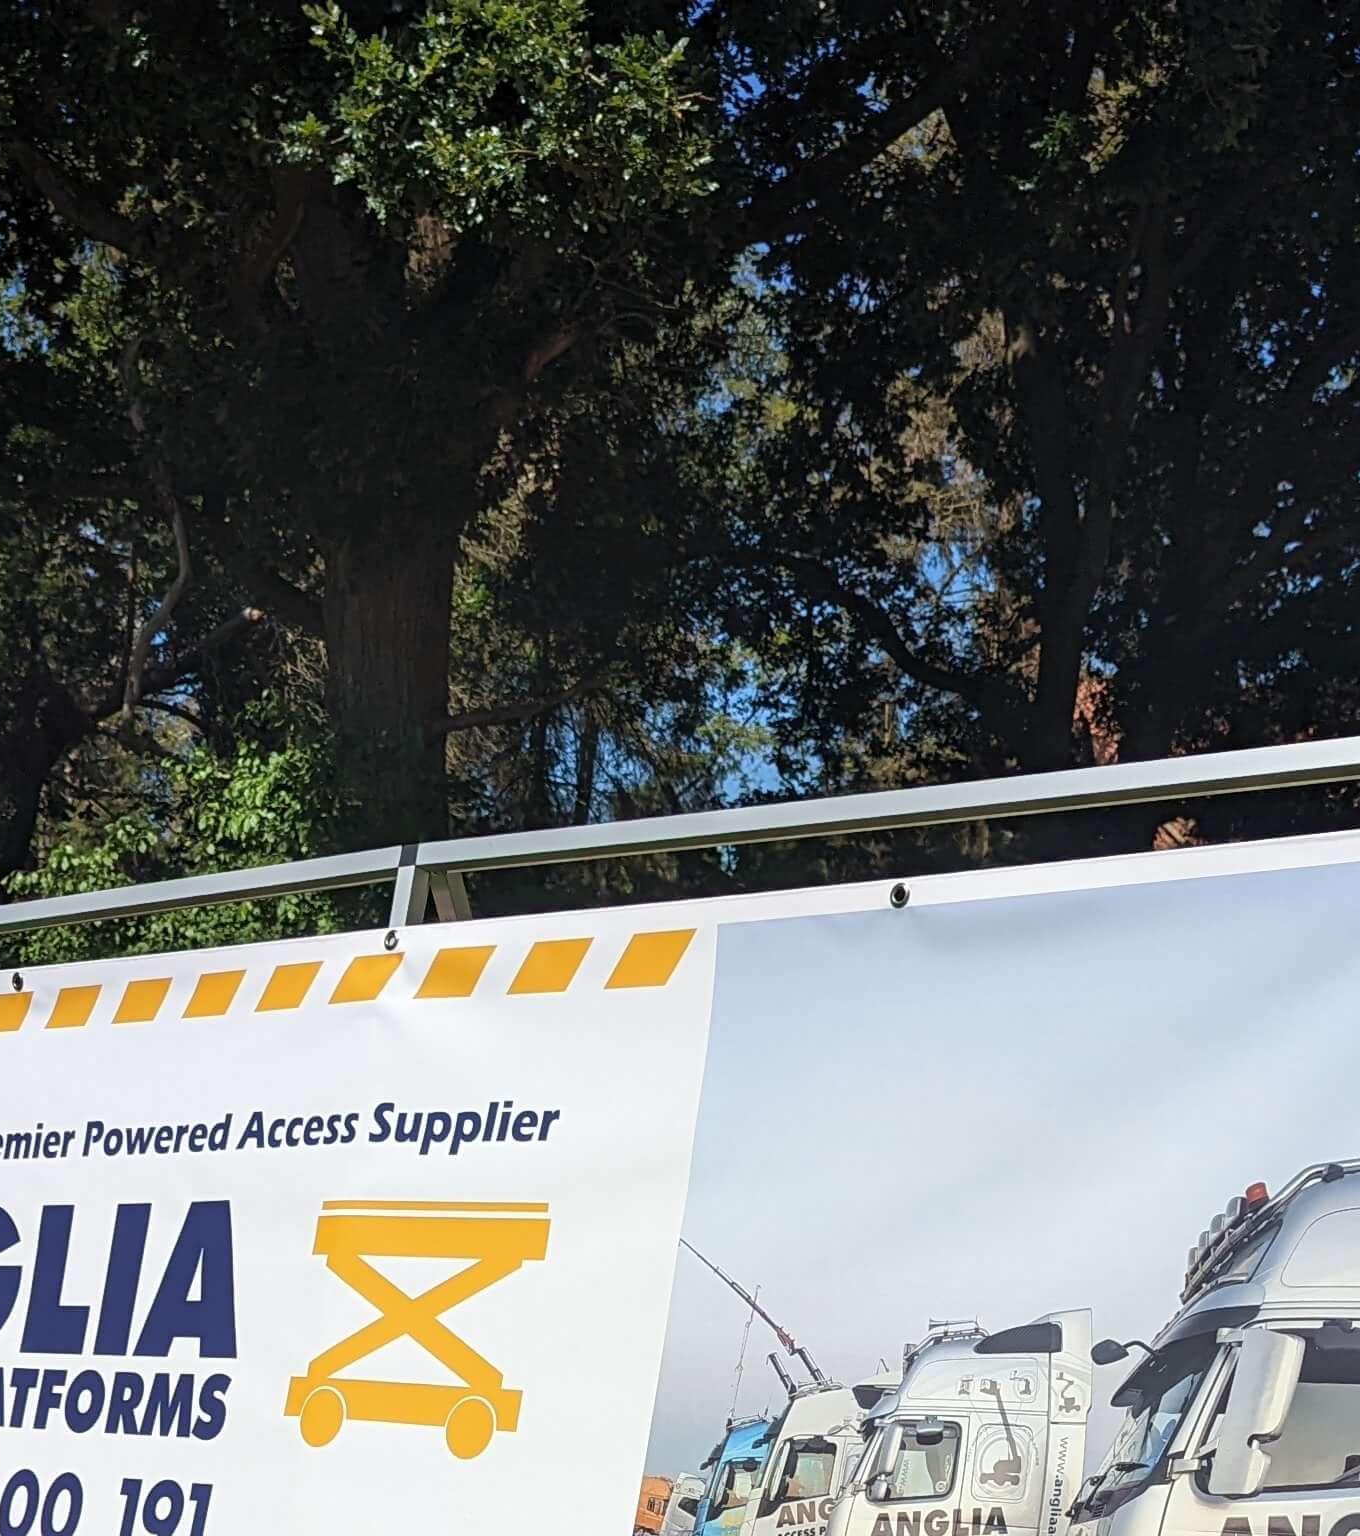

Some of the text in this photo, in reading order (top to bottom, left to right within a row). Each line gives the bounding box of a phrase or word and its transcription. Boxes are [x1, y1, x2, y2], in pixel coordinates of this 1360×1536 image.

[82, 1112, 233, 1157] Powered
[235, 1108, 360, 1151] Access
[367, 1100, 561, 1156] Supplier
